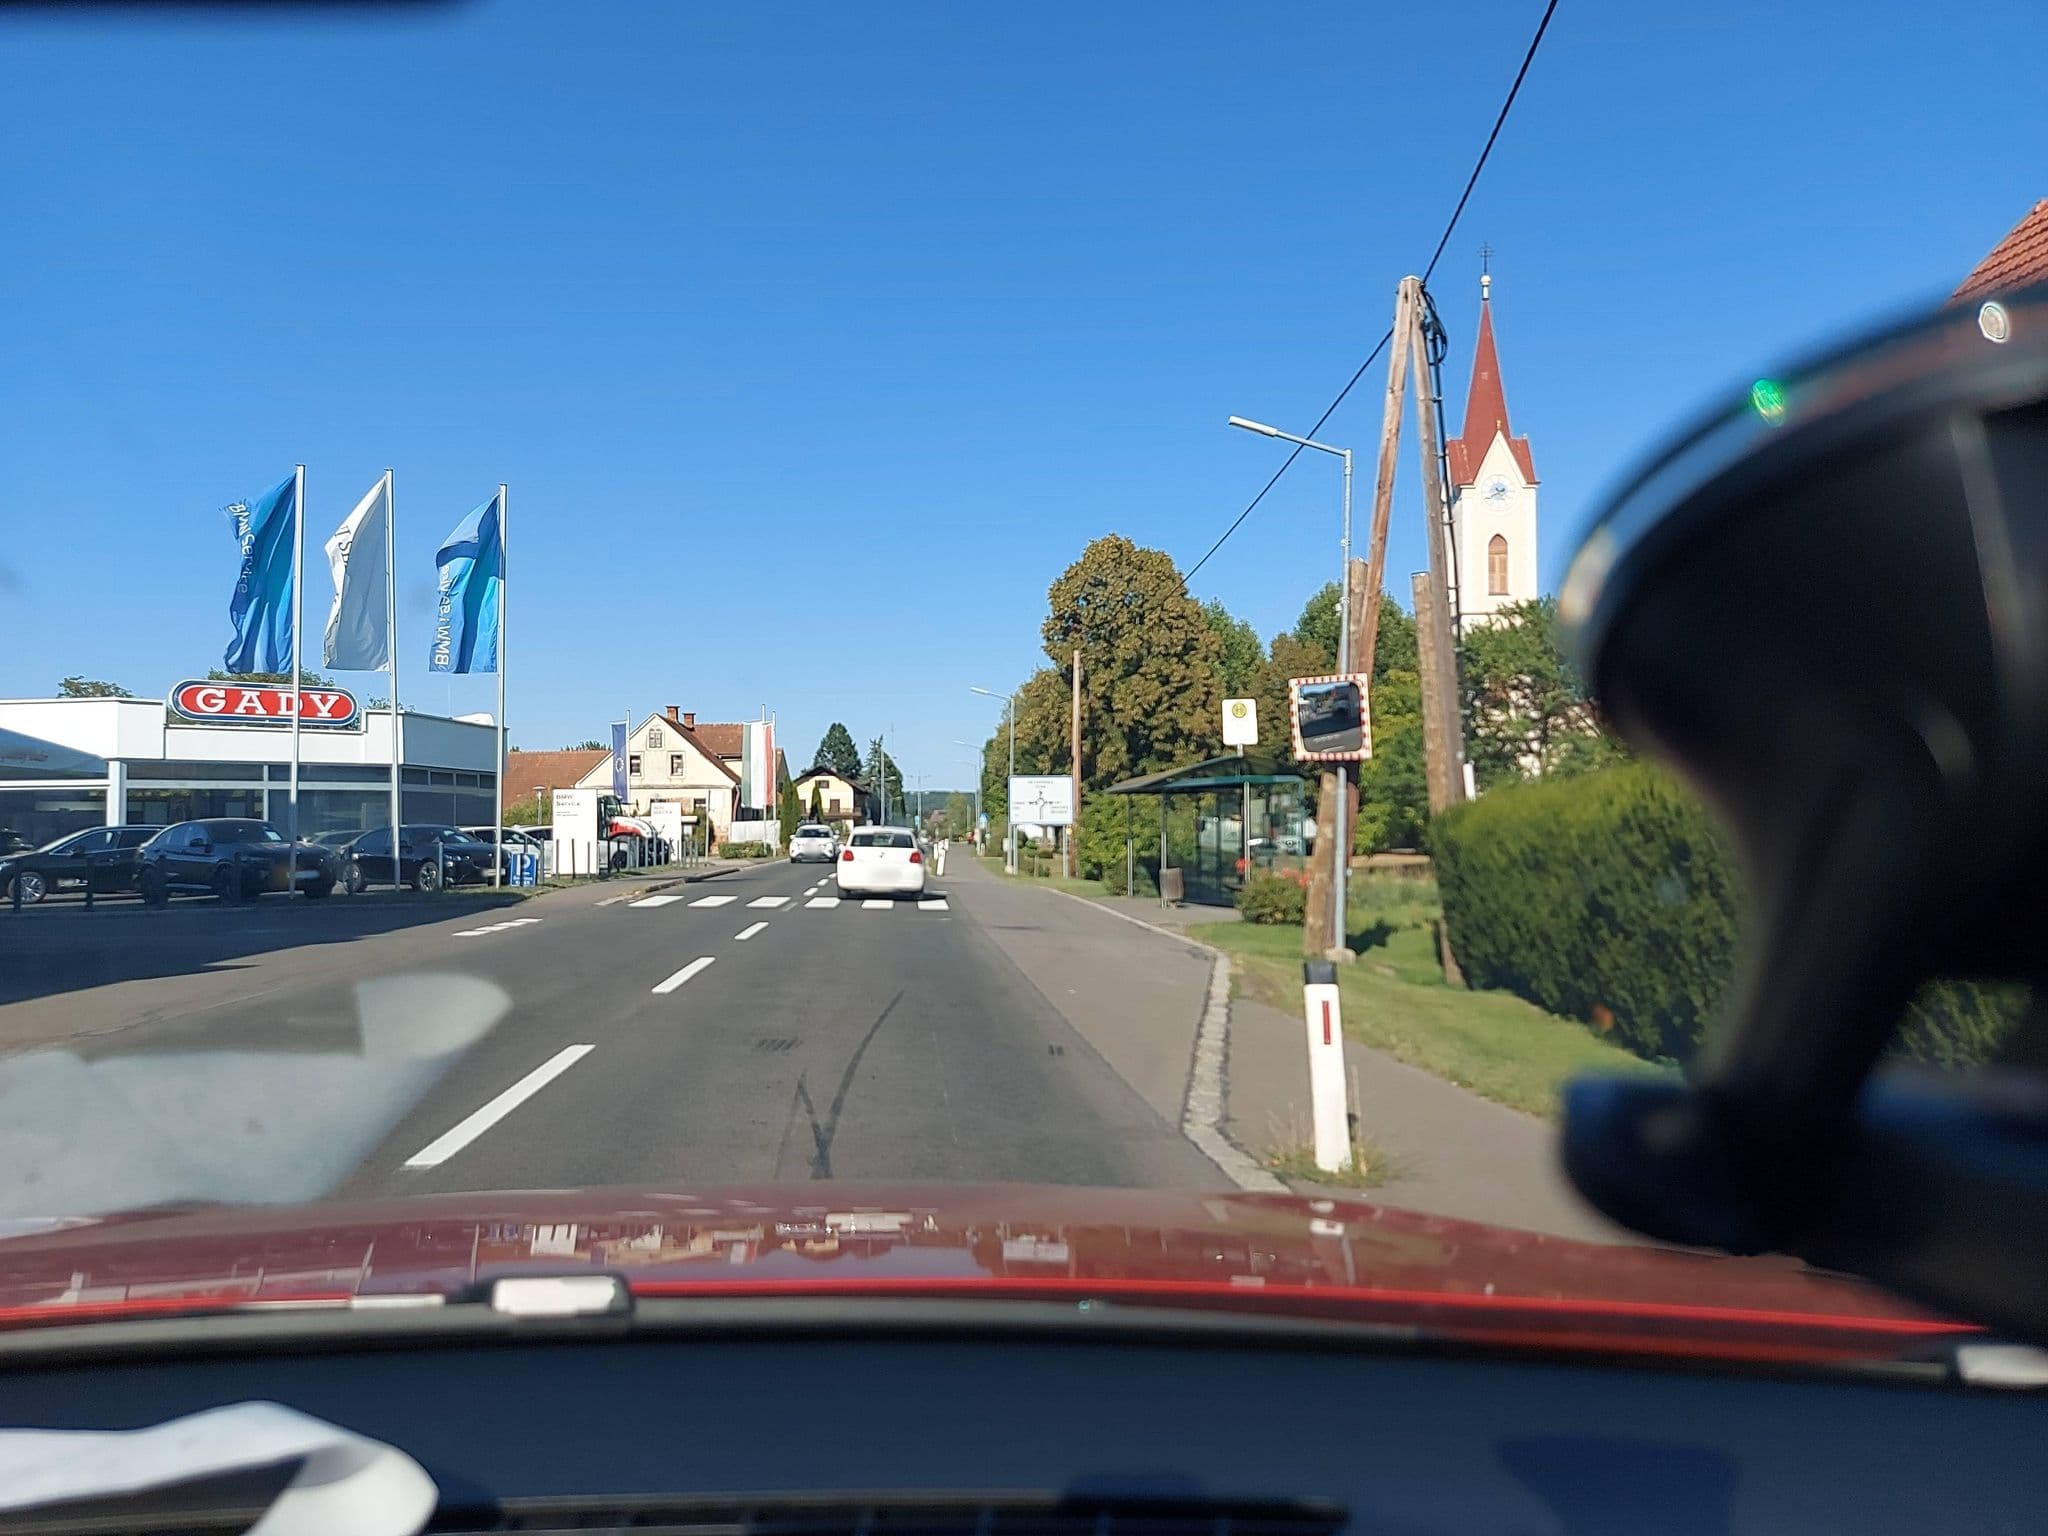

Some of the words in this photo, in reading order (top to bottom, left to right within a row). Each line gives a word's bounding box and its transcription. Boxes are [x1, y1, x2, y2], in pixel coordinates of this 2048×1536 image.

[228, 504, 252, 536] BMW
[238, 534, 255, 593] Service
[196, 688, 339, 718] GADY
